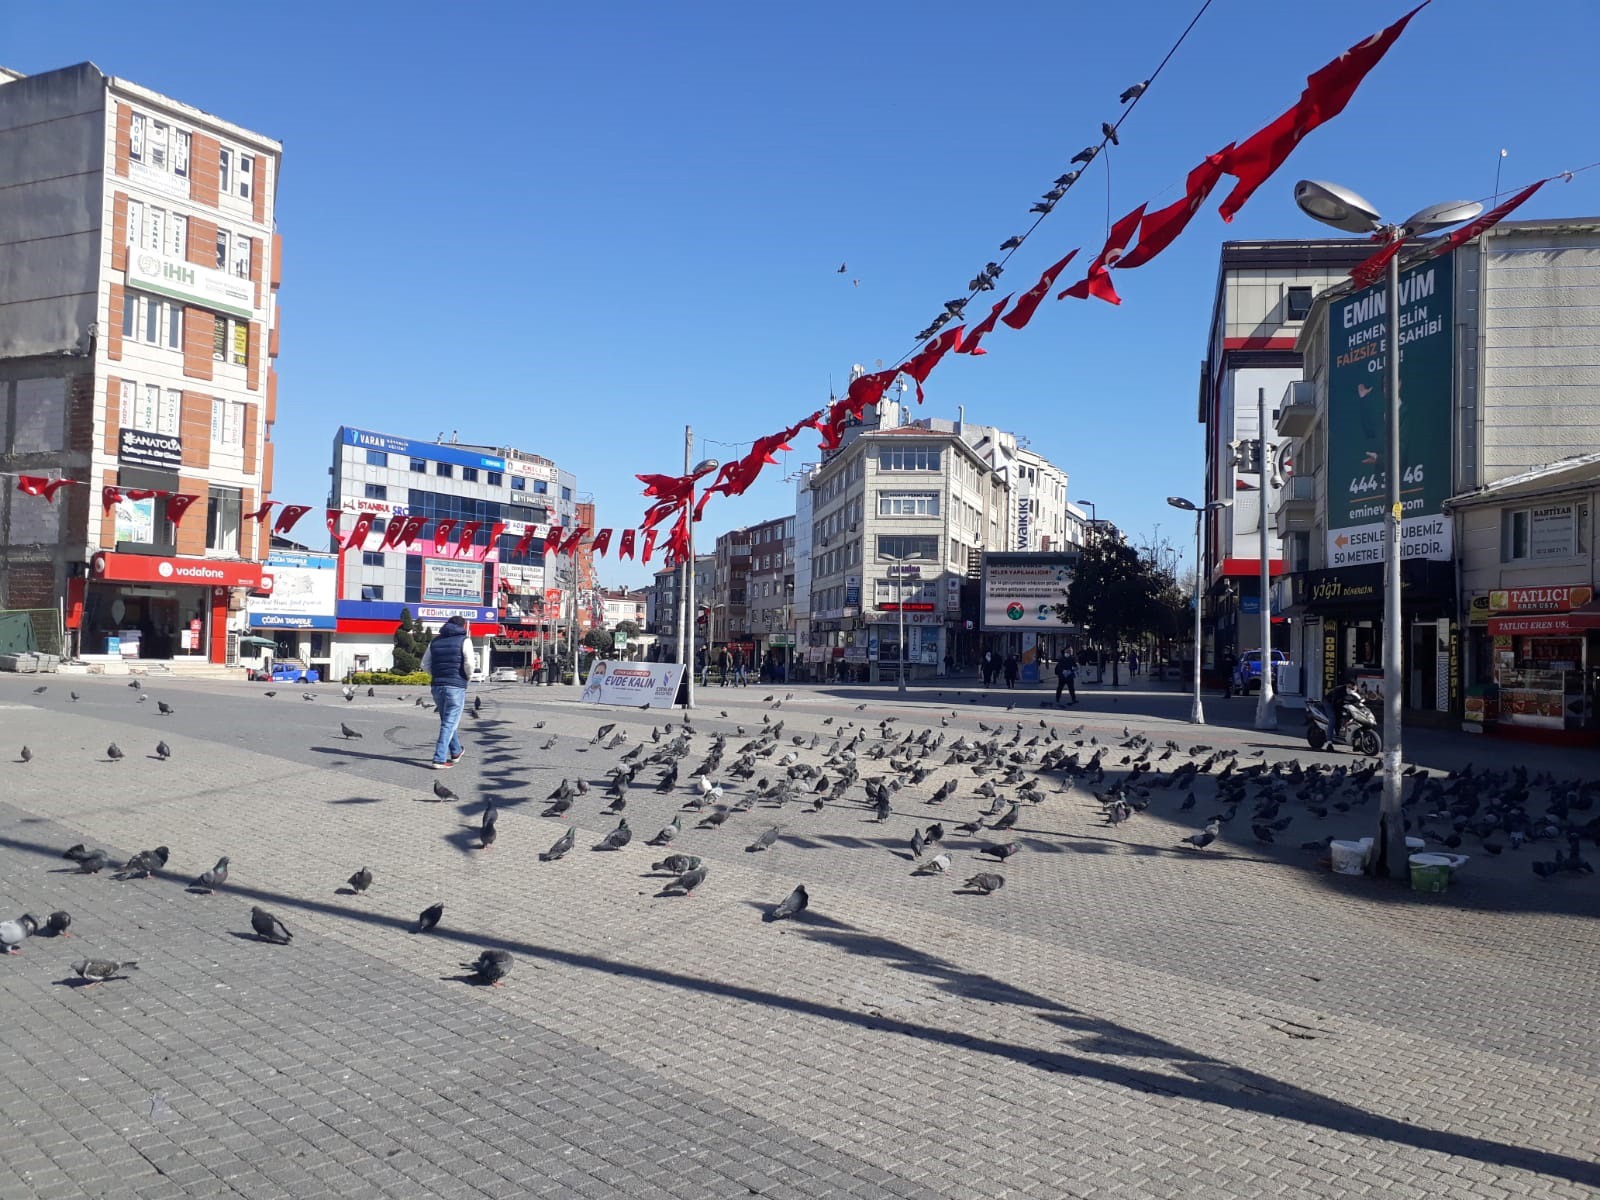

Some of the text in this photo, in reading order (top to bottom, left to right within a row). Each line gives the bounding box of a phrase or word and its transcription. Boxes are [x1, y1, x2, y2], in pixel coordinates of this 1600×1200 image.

[1343, 269, 1435, 329] EMİNVİM
[1399, 305, 1428, 328] ELİN
[1336, 342, 1377, 368] FAİZSİZ
[360, 434, 385, 447] VARAN
[1349, 474, 1378, 494] 444
[1403, 464, 1424, 484] 46
[357, 499, 391, 513] İSTANBUL
[1350, 520, 1444, 545] ESENLE UBEMİZ
[1334, 551, 1345, 564] 50
[1347, 548, 1379, 563] METRE
[176, 566, 224, 578] vodafone
[1510, 588, 1569, 603] TATLICI
[1530, 621, 1553, 629] EREN
[605, 675, 656, 688] EVDE KALIN
